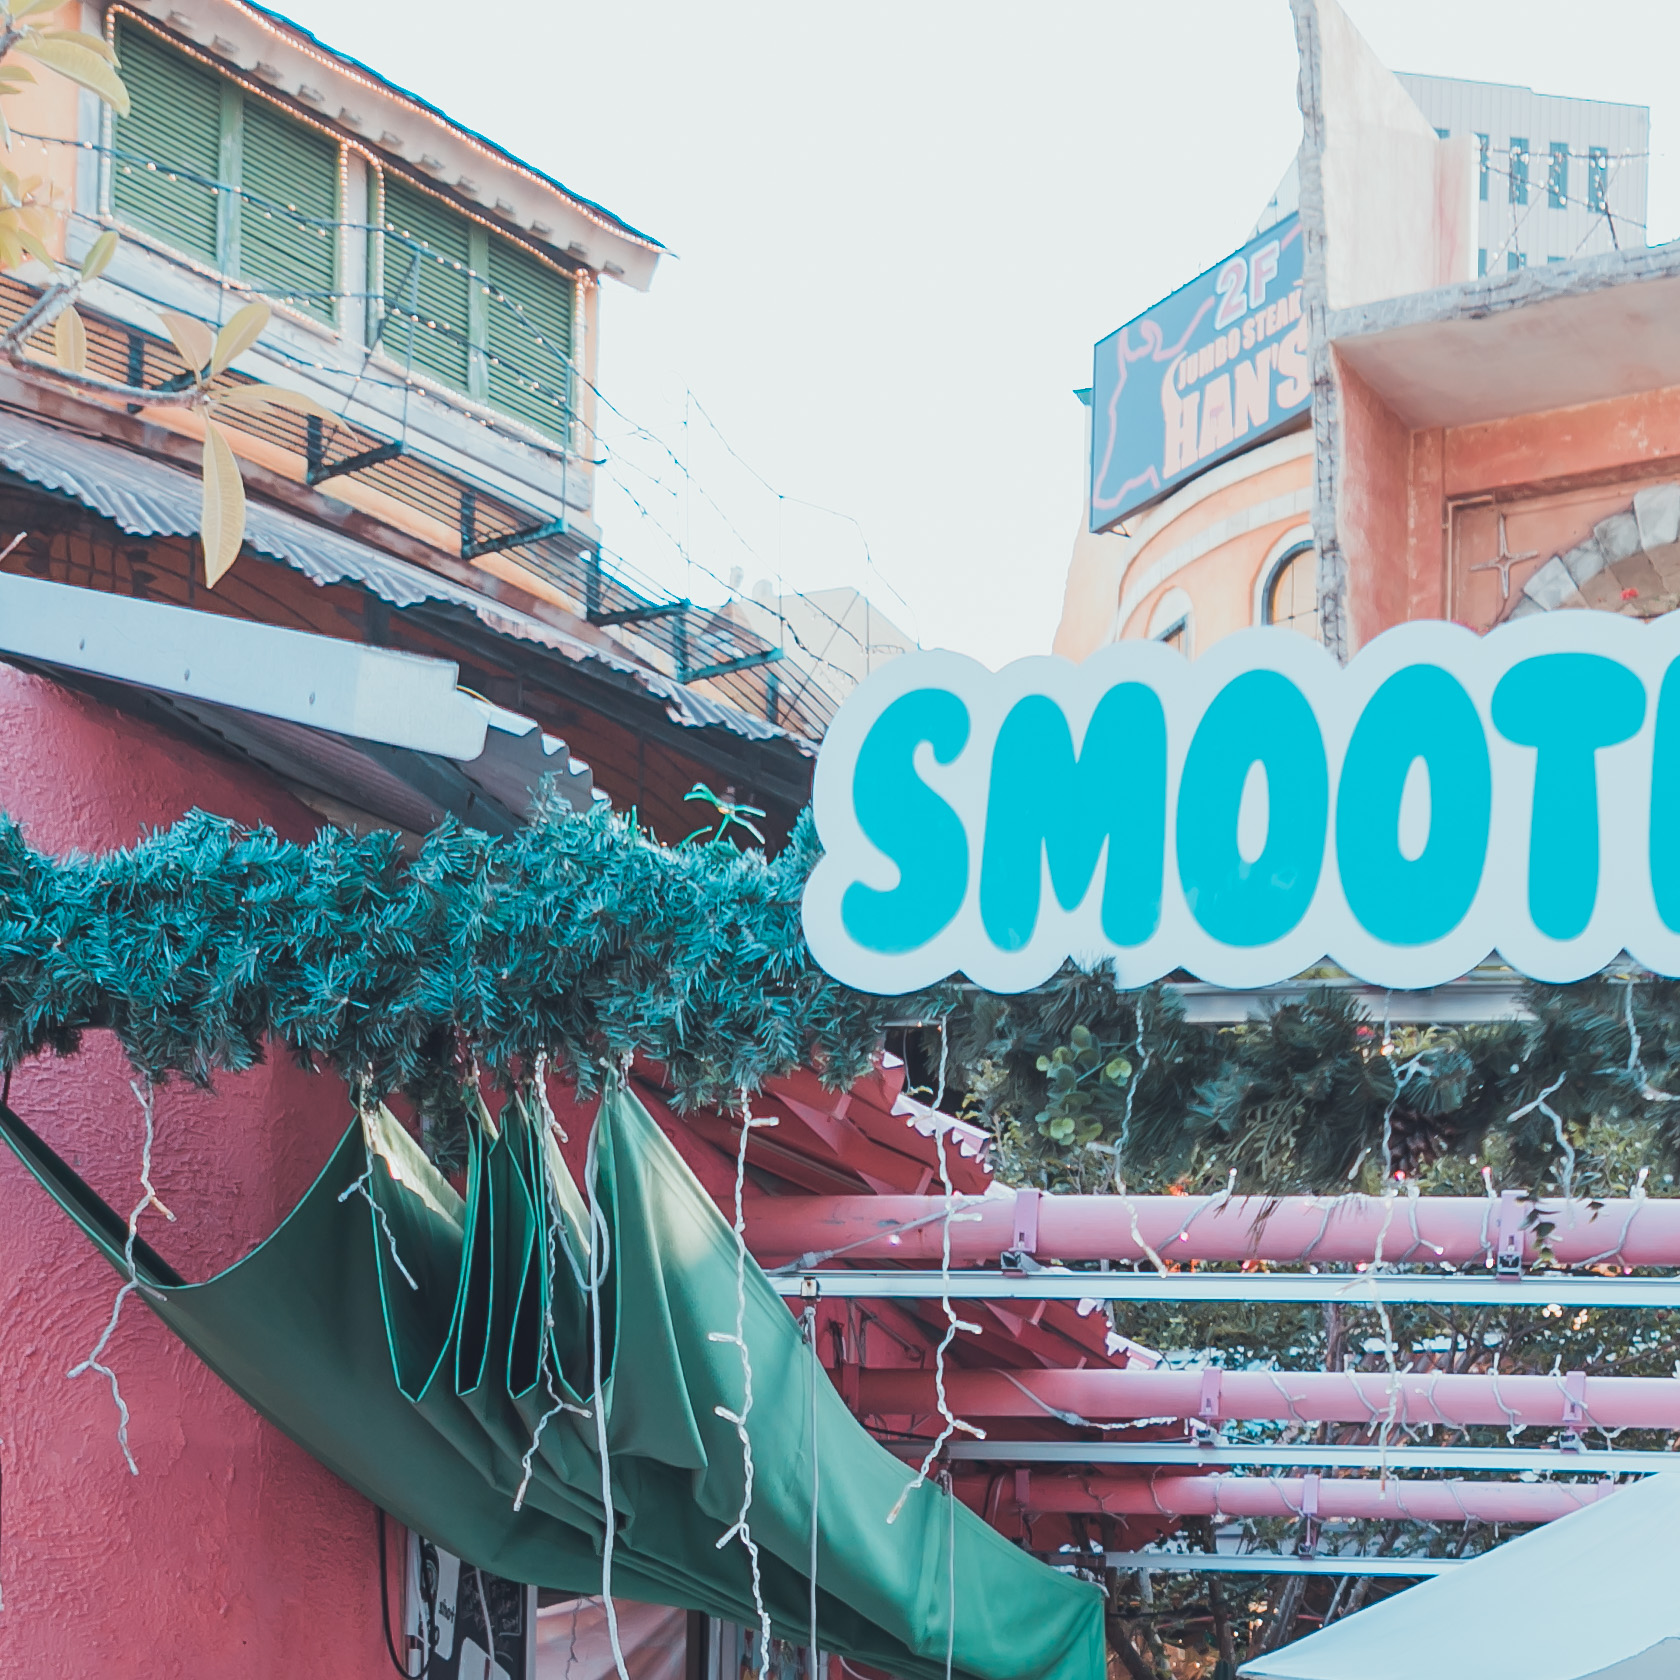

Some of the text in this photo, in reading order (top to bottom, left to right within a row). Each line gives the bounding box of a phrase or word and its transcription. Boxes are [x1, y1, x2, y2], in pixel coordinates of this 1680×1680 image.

[1214, 240, 1281, 331] 2F
[1162, 312, 1313, 480] HAN'S
[1177, 327, 1240, 391] JUMBO
